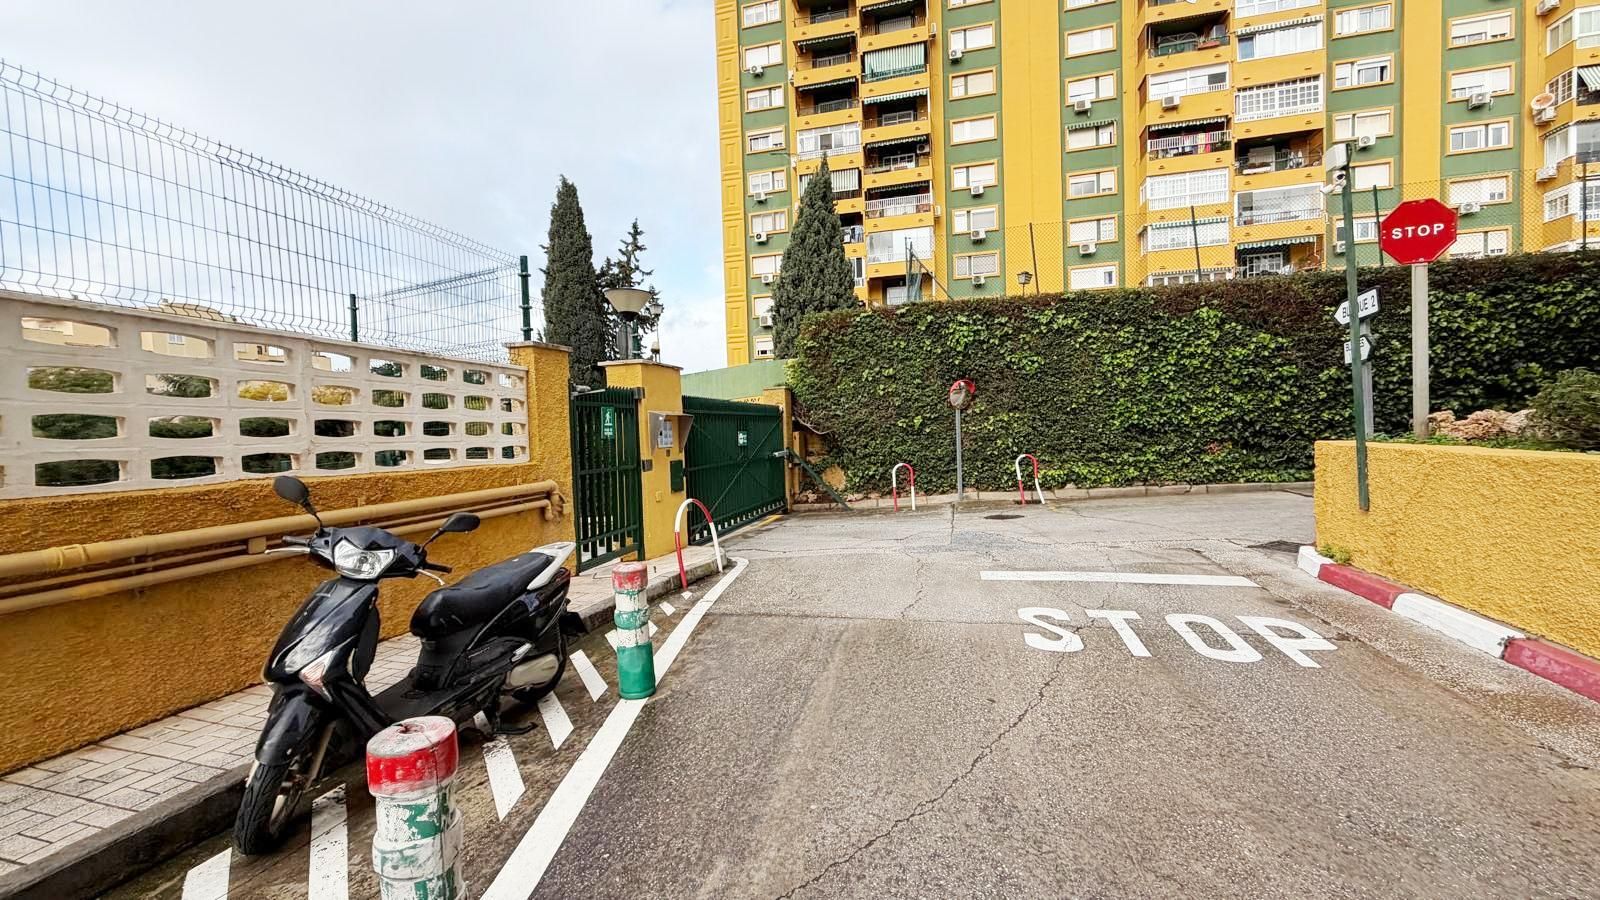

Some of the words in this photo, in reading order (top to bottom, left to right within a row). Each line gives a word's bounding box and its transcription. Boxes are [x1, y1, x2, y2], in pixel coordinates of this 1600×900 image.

[1391, 223, 1445, 240] STOP
[1342, 297, 1369, 319] BLUE
[1370, 294, 1376, 308] 2
[1017, 606, 1338, 669] STOP
